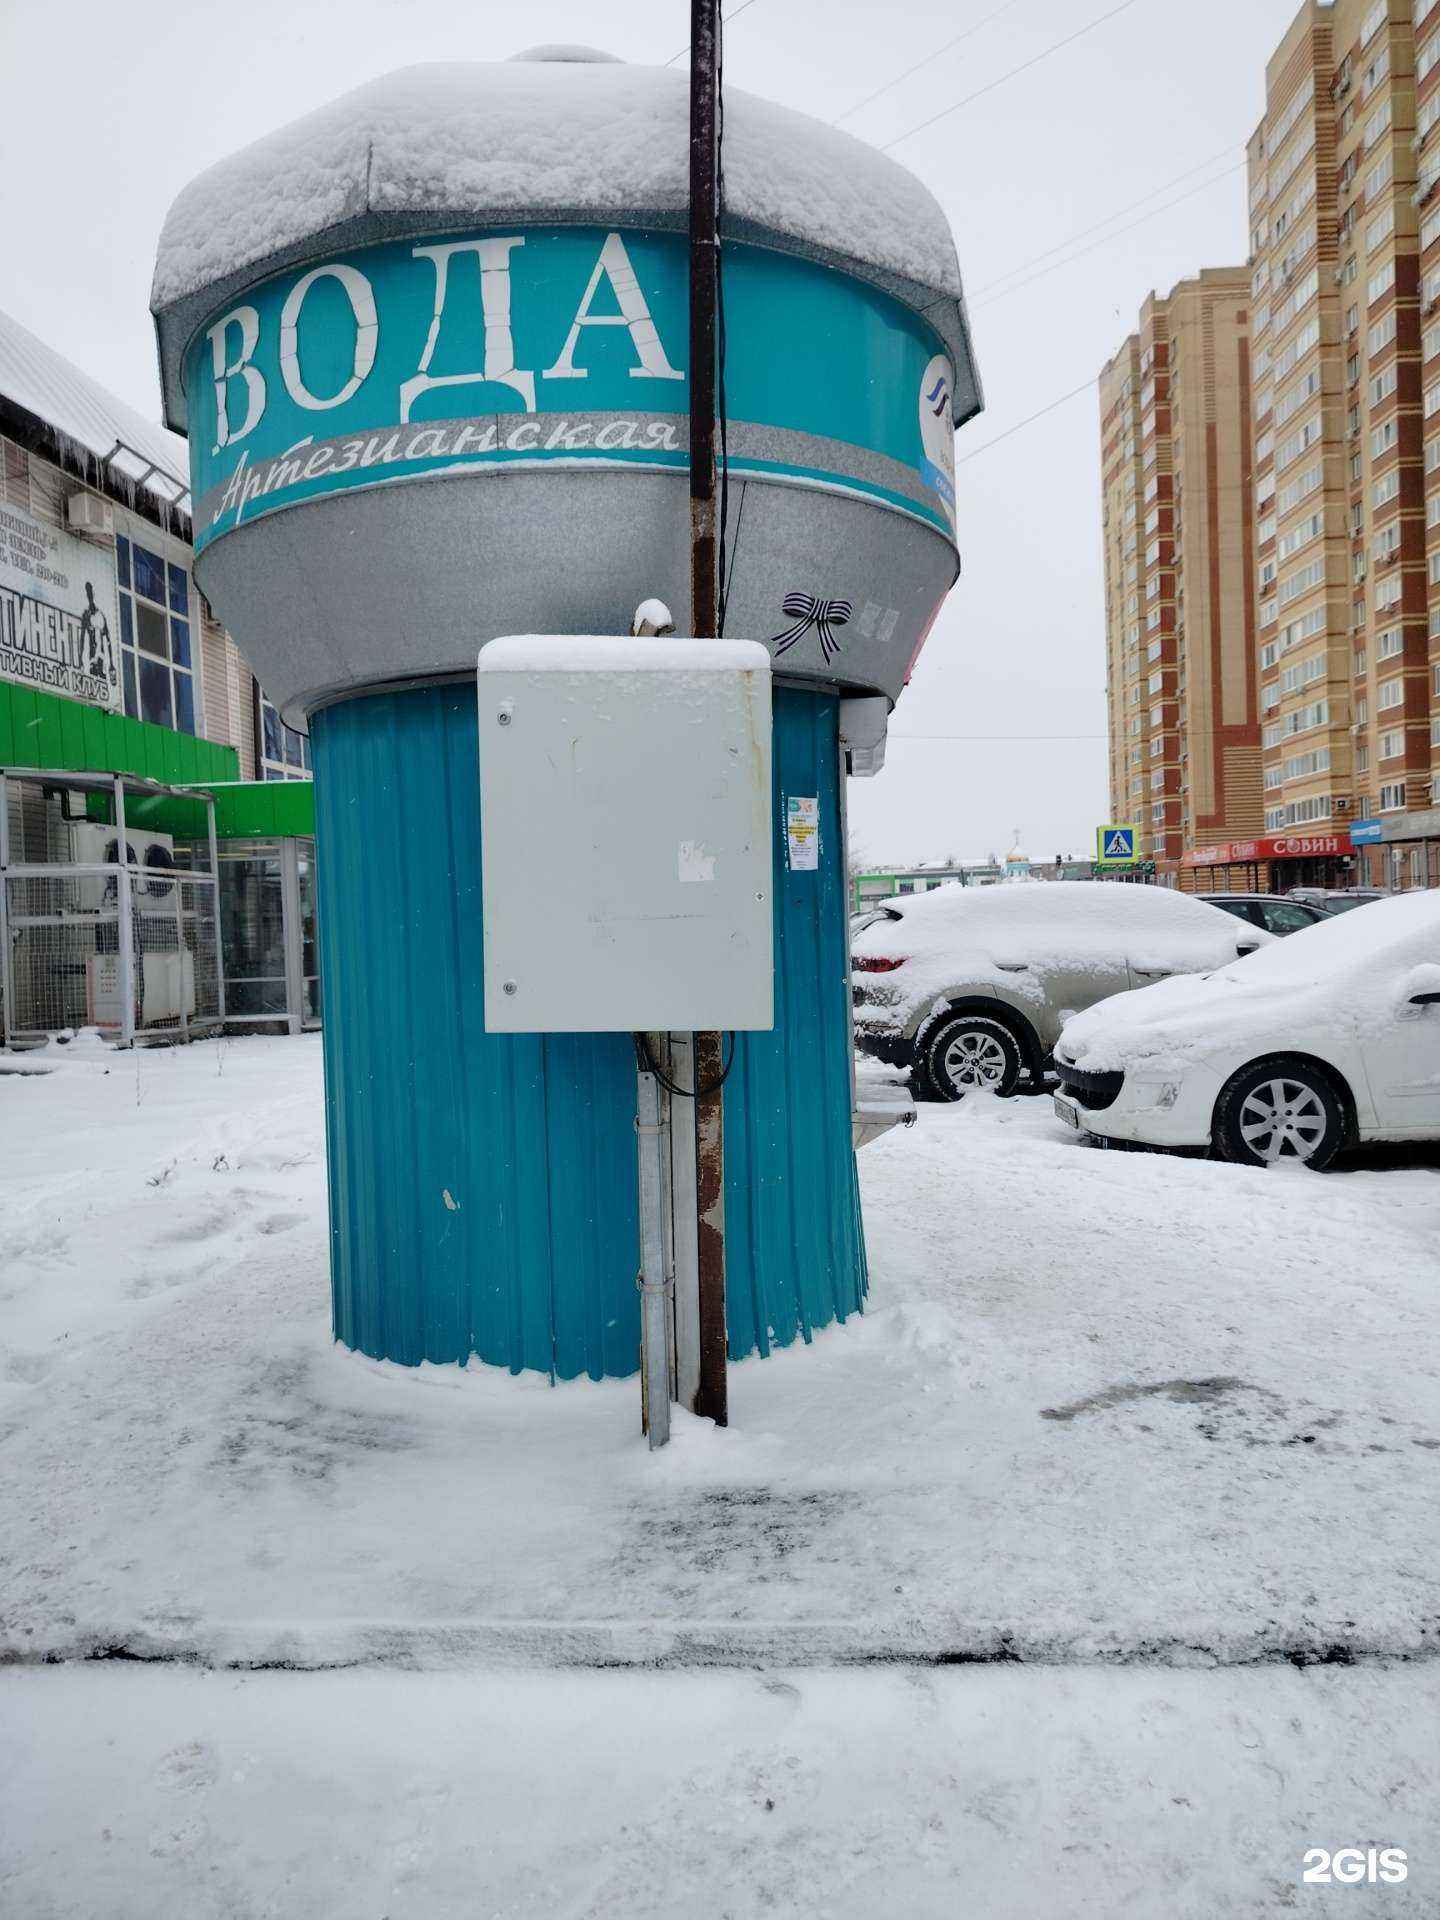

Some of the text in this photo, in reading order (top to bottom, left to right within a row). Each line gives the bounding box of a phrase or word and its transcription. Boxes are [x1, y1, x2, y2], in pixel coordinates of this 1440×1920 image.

[206, 233, 685, 457] ВОДА
[213, 420, 680, 525] Артезианская
[72, 670, 110, 702] КЛУБ
